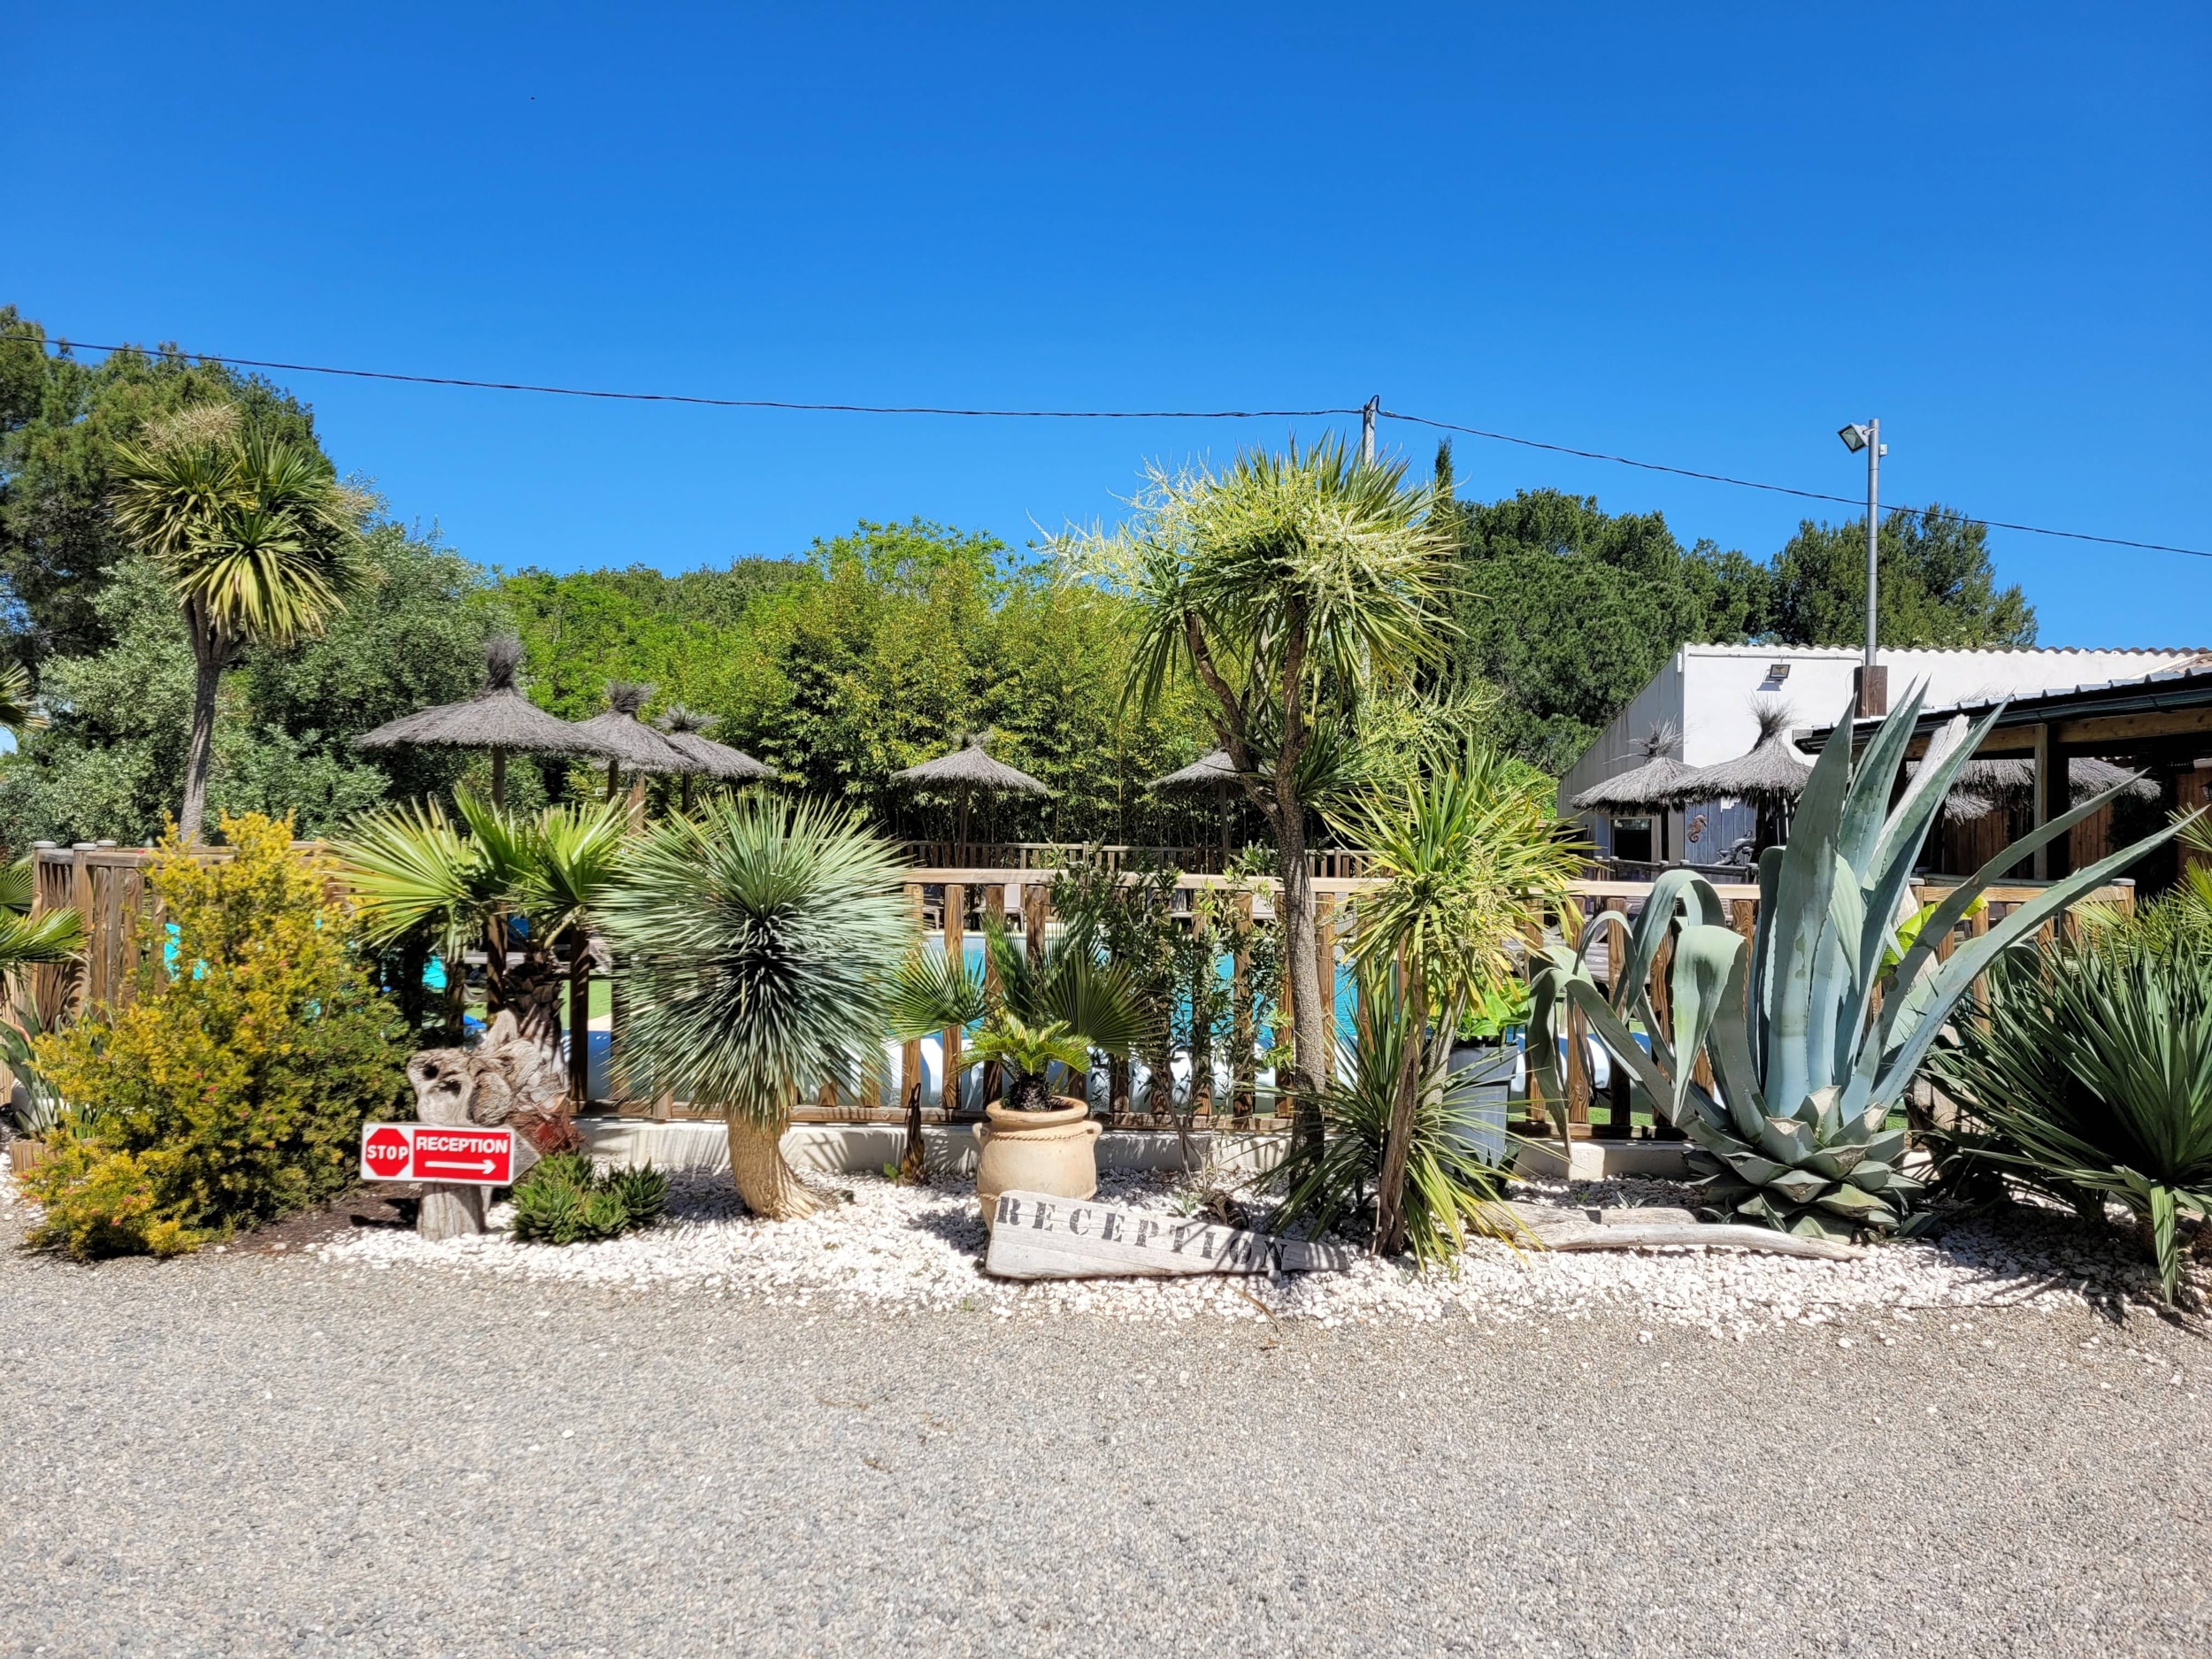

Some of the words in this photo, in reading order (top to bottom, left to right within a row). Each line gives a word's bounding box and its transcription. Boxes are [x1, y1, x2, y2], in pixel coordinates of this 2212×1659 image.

[366, 1144, 409, 1160] STOP
[416, 1136, 509, 1154] RECEPTION
[996, 1195, 1286, 1269] RECEPTION
